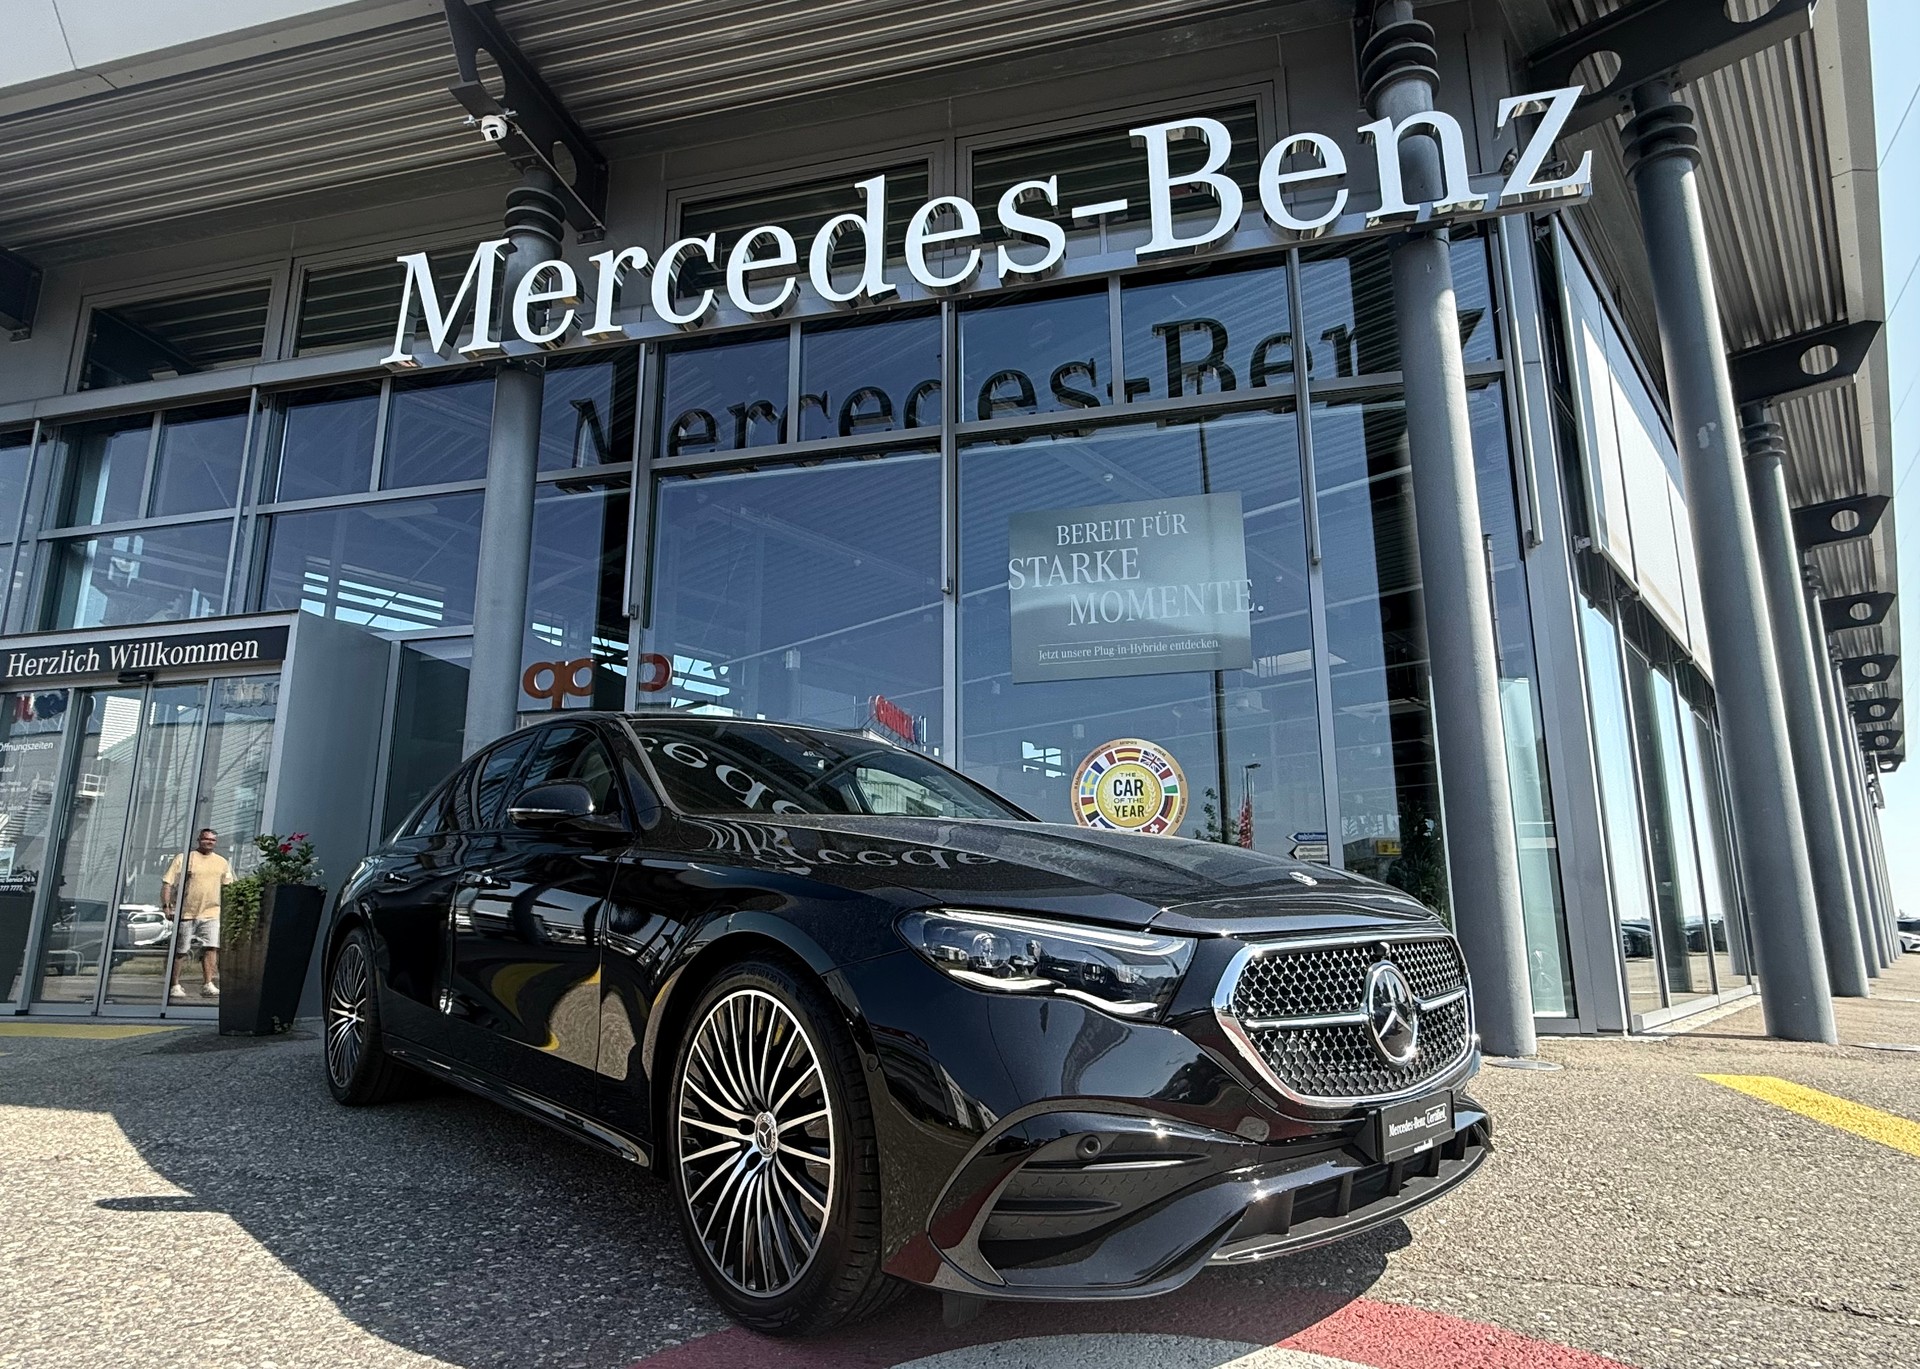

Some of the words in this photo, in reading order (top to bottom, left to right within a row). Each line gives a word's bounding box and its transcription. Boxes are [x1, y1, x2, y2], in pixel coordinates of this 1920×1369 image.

[379, 85, 1593, 368] Mercedes-Benz
[1056, 518, 1136, 546] BEREIT
[1142, 511, 1189, 538] FÜR
[1007, 547, 1141, 591] STARKE
[1067, 579, 1265, 626] MOMENTE.
[5, 648, 100, 678] Herzlich
[109, 640, 259, 670] Willkommen
[1038, 650, 1059, 662] Jetzt
[1061, 648, 1092, 660] unsere
[1094, 642, 1168, 657] Plug-in-Hybride
[1113, 779, 1144, 797] CAR
[1114, 805, 1145, 818] YEAR
[1388, 1116, 1426, 1138] Mercedes-Benz
[1426, 1106, 1446, 1125] Certified
